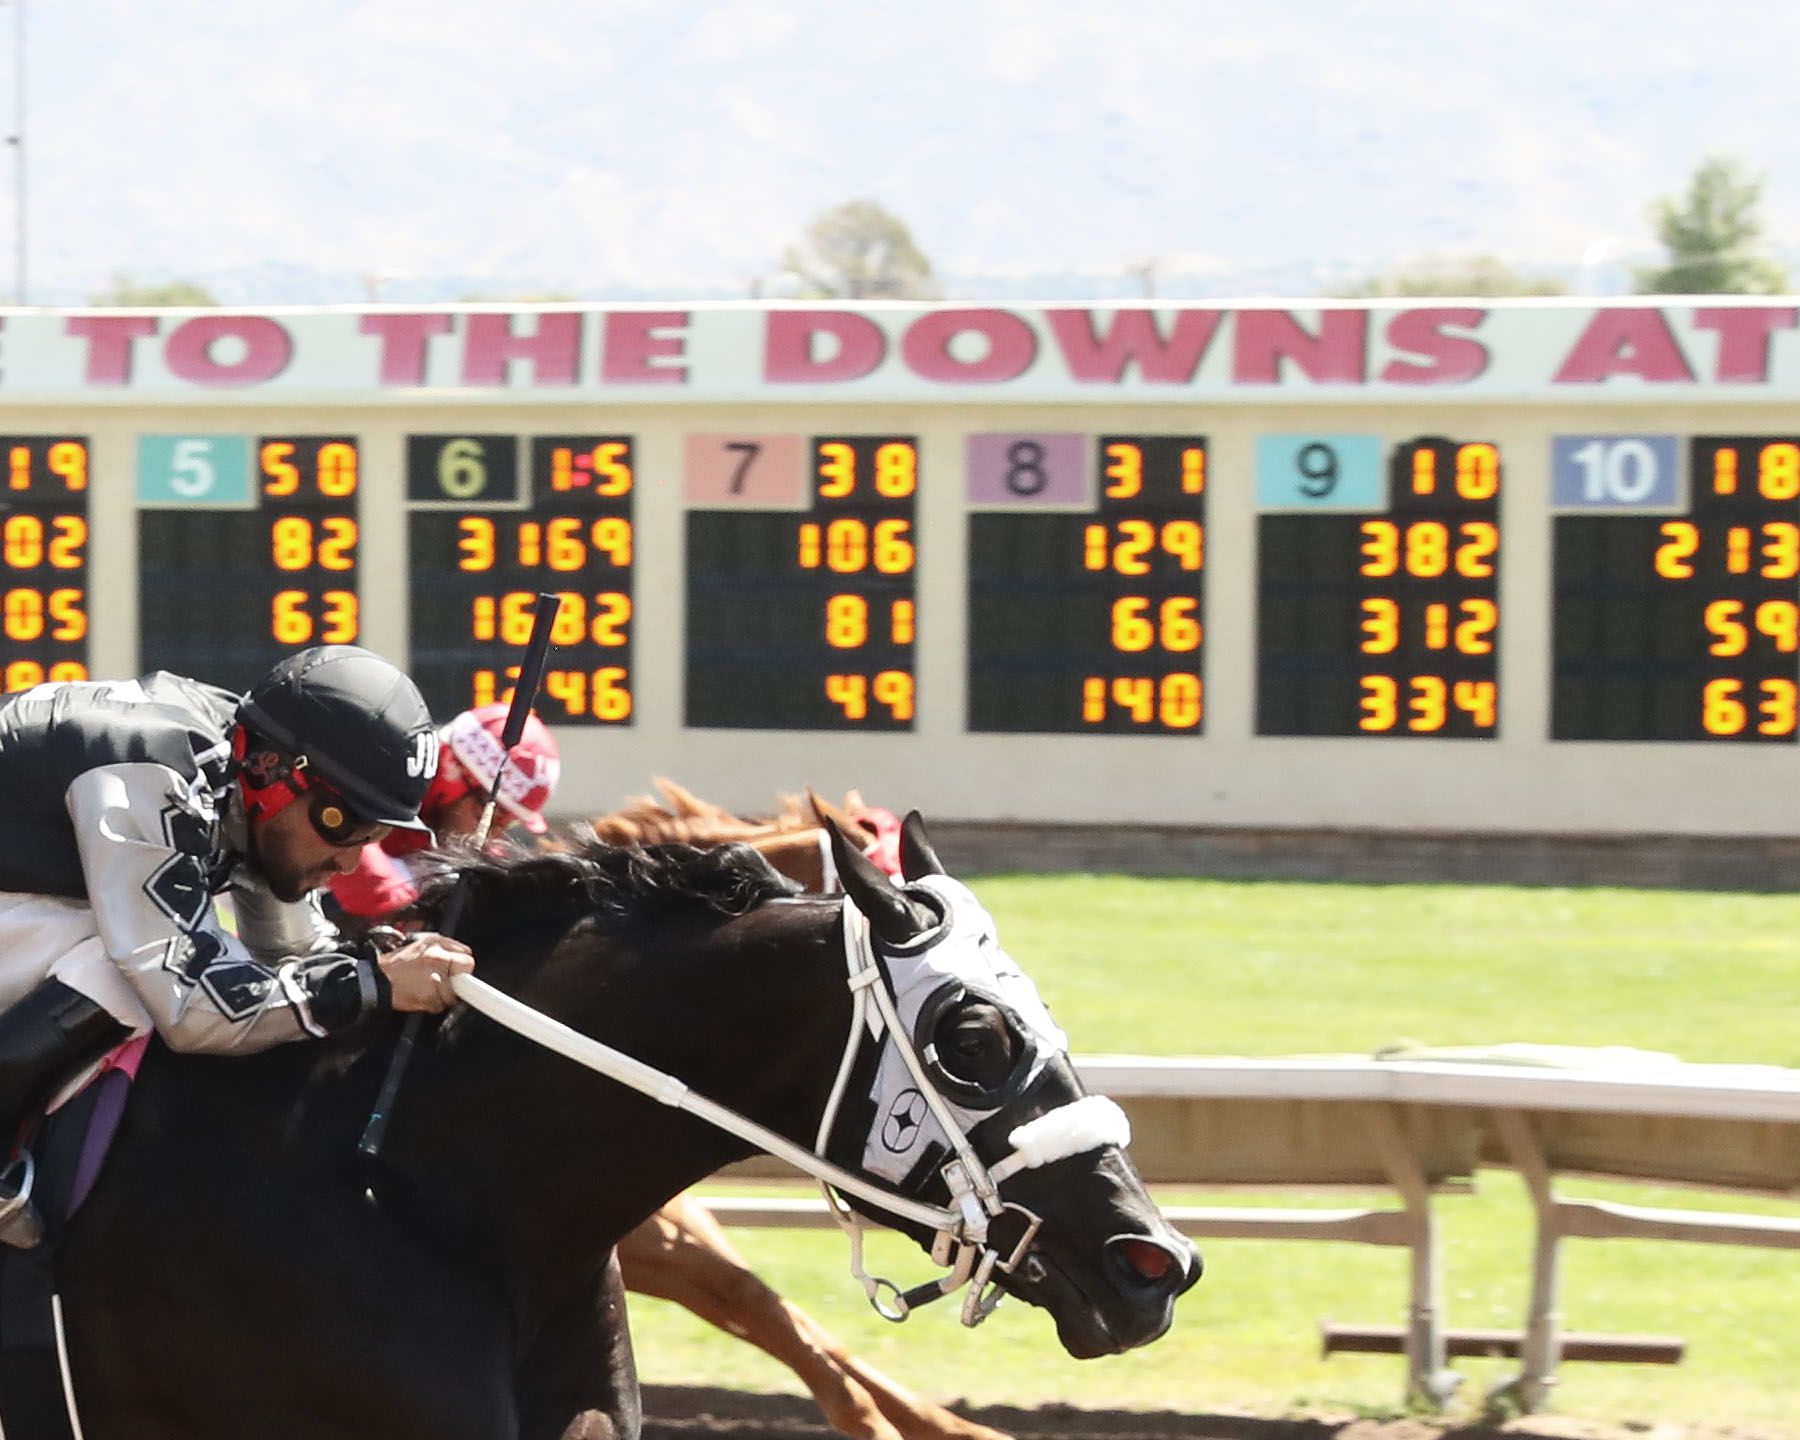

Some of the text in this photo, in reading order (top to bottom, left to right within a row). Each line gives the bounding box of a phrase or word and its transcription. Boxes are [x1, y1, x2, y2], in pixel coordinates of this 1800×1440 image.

[67, 316, 293, 386] TO
[362, 312, 690, 385] THE
[764, 309, 1489, 384] DOWNS
[1551, 307, 1797, 383] AT
[7, 440, 89, 492] 19
[171, 440, 215, 497] 5
[259, 440, 360, 498] 50
[437, 439, 487, 498] 6
[724, 442, 763, 496] 7
[818, 441, 919, 500] 38
[1006, 441, 1047, 498] 8
[1298, 443, 1338, 498] 9
[1411, 441, 1502, 501] 10
[1571, 442, 1657, 502] 10
[1712, 441, 1800, 502] 18
[270, 515, 360, 572] 82
[457, 515, 634, 573] 3169
[797, 517, 918, 576] 106
[1083, 518, 1206, 577] 129
[1358, 519, 1502, 579] 382
[1653, 519, 1800, 581] 213
[271, 588, 361, 646] 63
[472, 590, 634, 648] 1682
[824, 592, 917, 650] 81
[1110, 595, 1204, 654] 66
[1359, 596, 1501, 657] 312
[1703, 598, 1800, 658] 59
[824, 669, 917, 722] 49
[1081, 671, 1205, 730] 140
[1358, 673, 1499, 733] 334
[1701, 676, 1800, 737] 63
